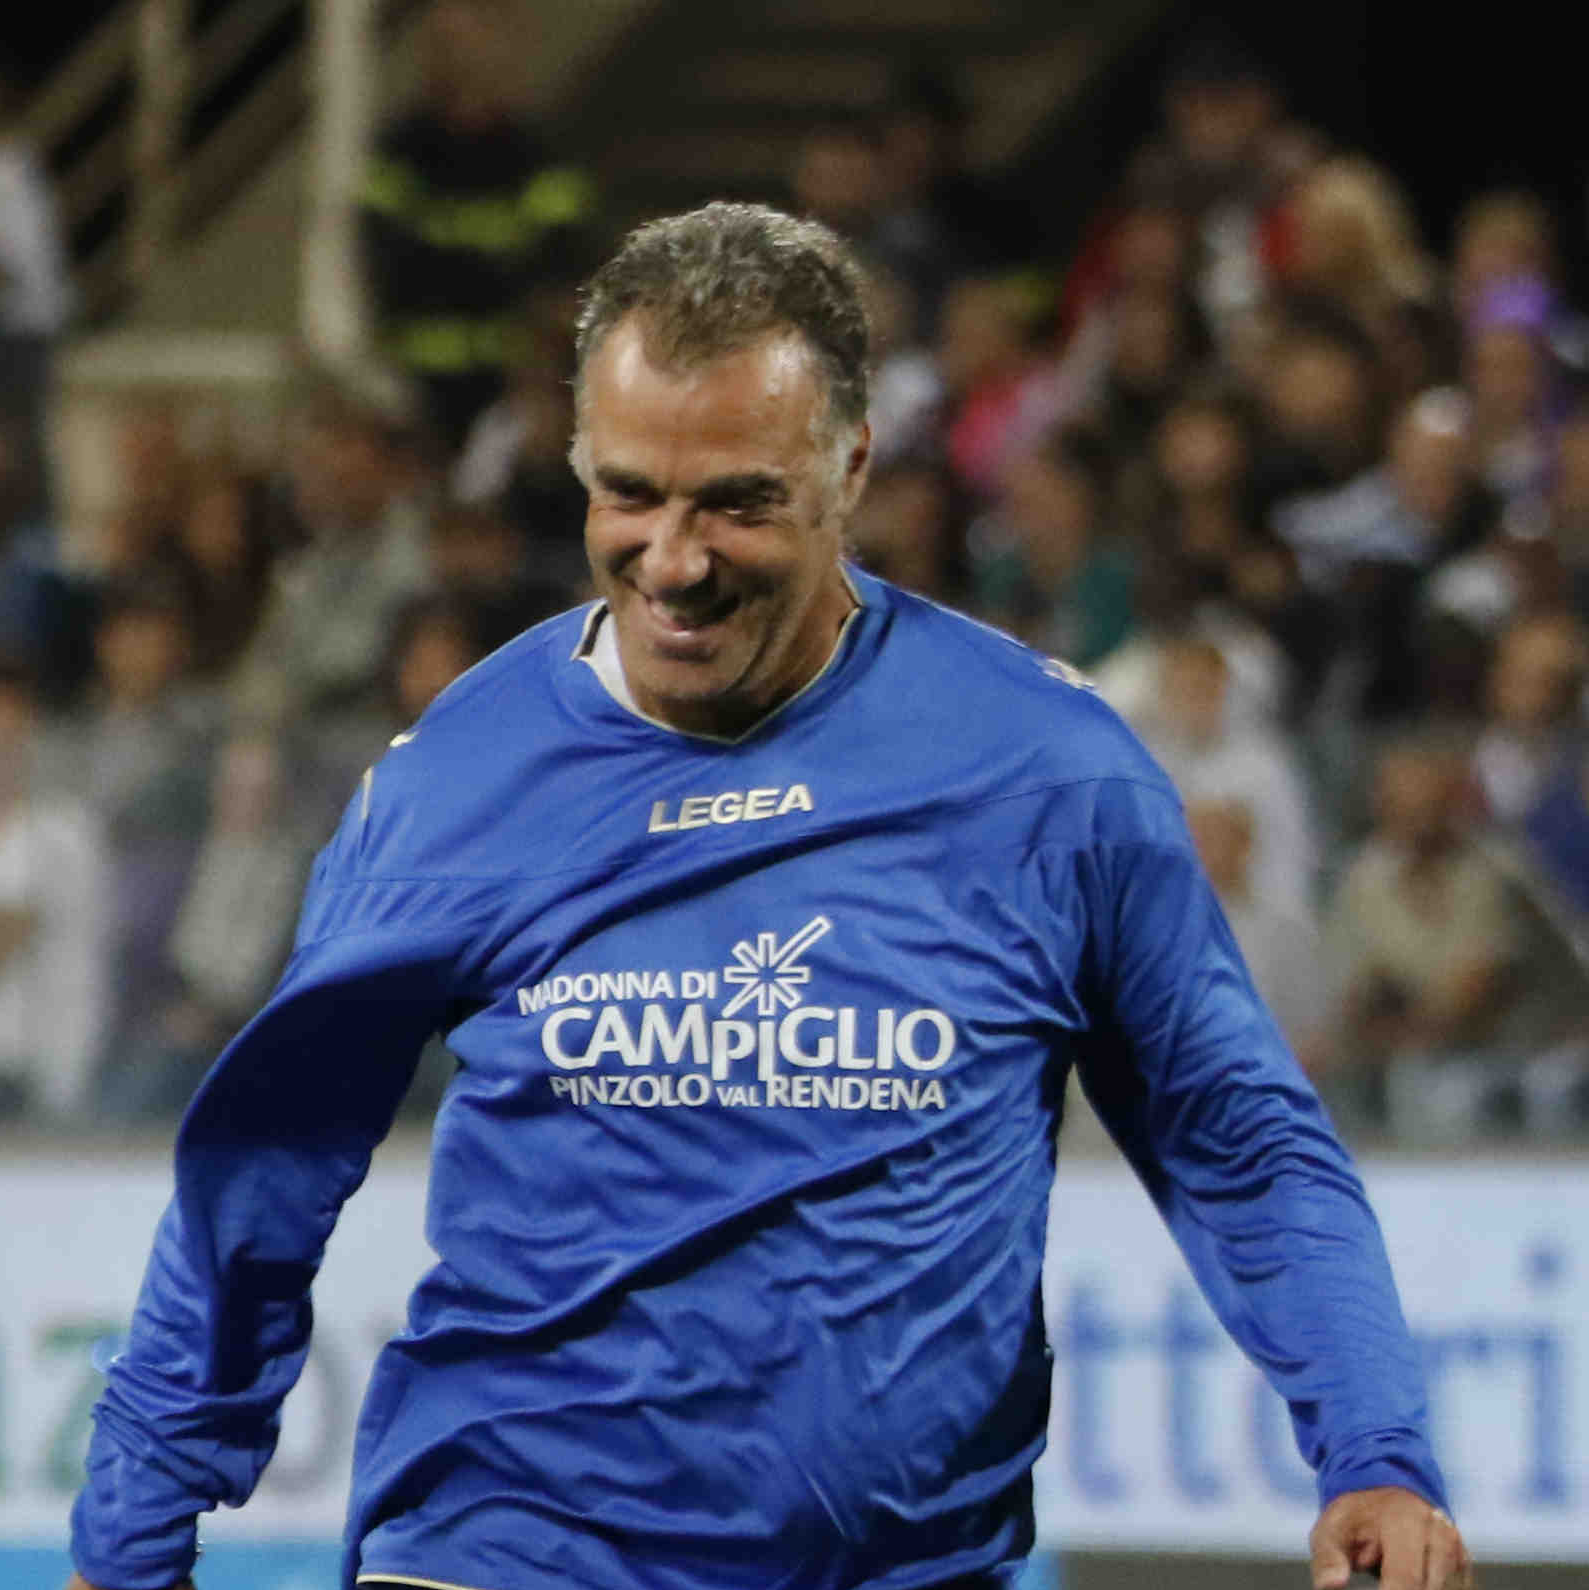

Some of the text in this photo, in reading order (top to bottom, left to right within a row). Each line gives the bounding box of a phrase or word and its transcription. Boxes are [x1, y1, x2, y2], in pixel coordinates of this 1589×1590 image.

[648, 784, 813, 833] LEGEA
[518, 971, 718, 1016] MADONNA DI
[541, 1003, 956, 1081] CAMPIGLIO
[549, 1073, 947, 1111] PINZOLO VAL RENDENA
